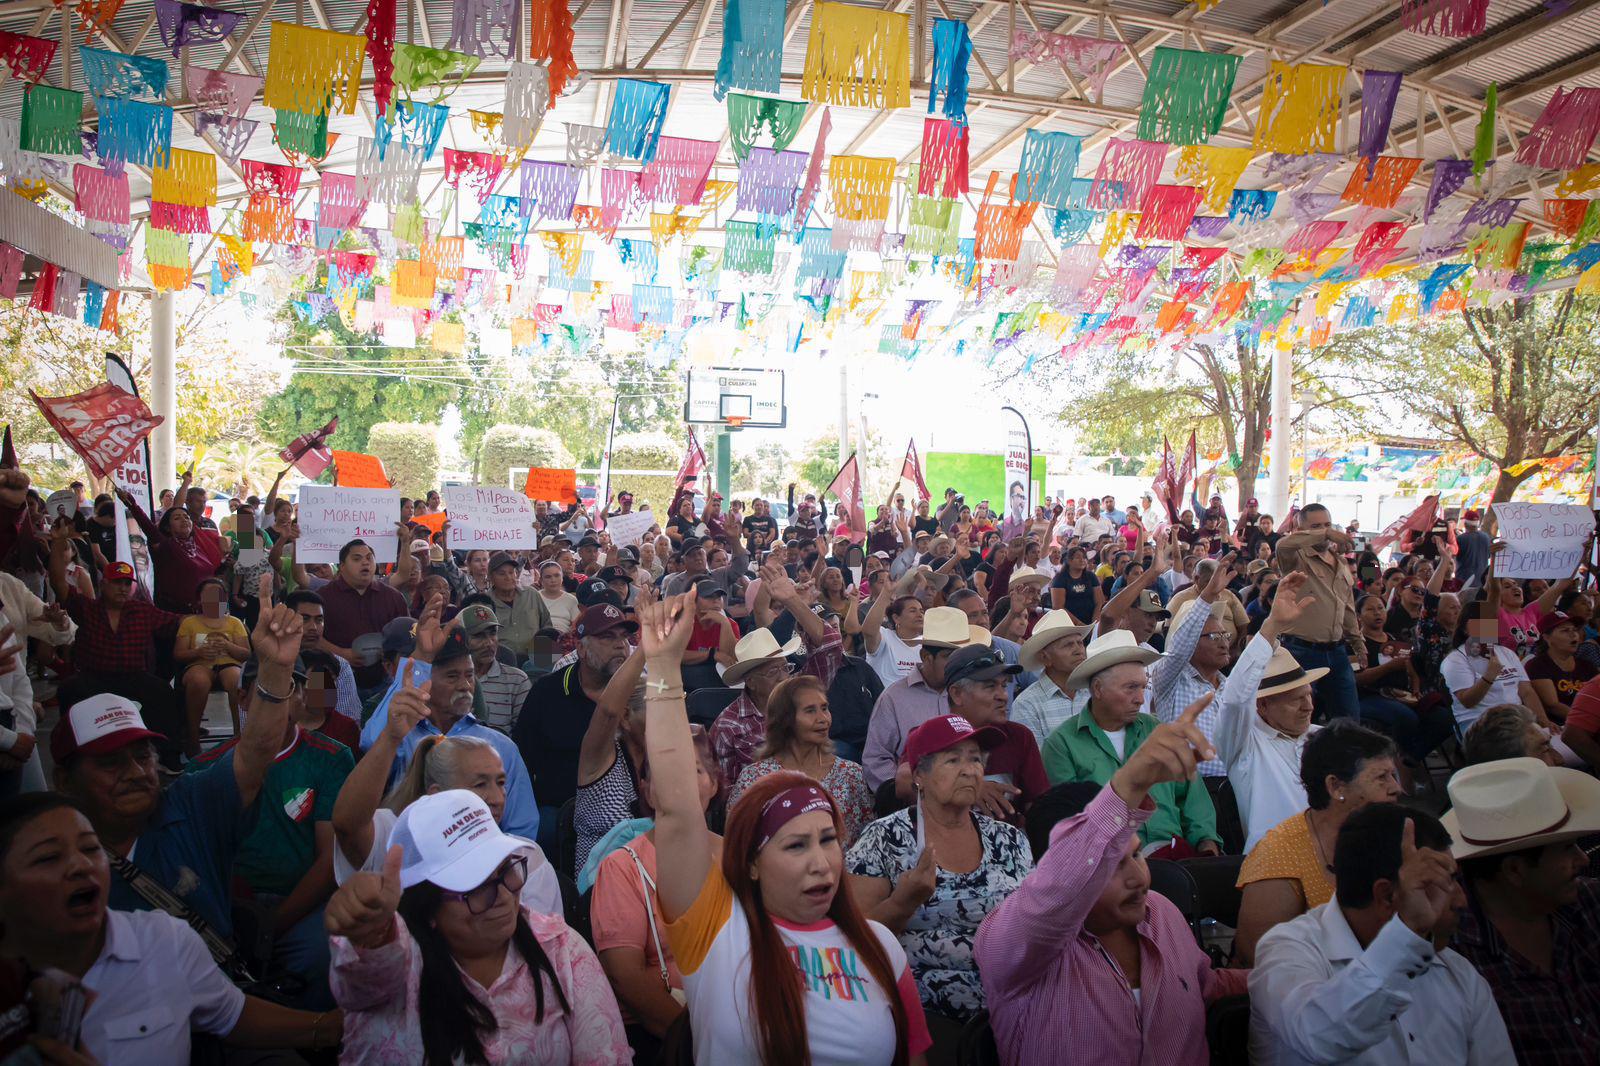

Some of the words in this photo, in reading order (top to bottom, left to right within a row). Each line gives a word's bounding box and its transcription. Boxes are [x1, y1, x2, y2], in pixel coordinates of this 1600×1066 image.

[323, 508, 376, 523] MORENA
[492, 505, 514, 515] Juan
[453, 528, 466, 542] EL
[474, 529, 523, 542] DRENAJE
[1541, 522, 1557, 539] de
[94, 712, 114, 724] JUAN
[801, 802, 818, 813] JUAN
[442, 818, 465, 839] JUAN
[463, 812, 475, 823] DE
